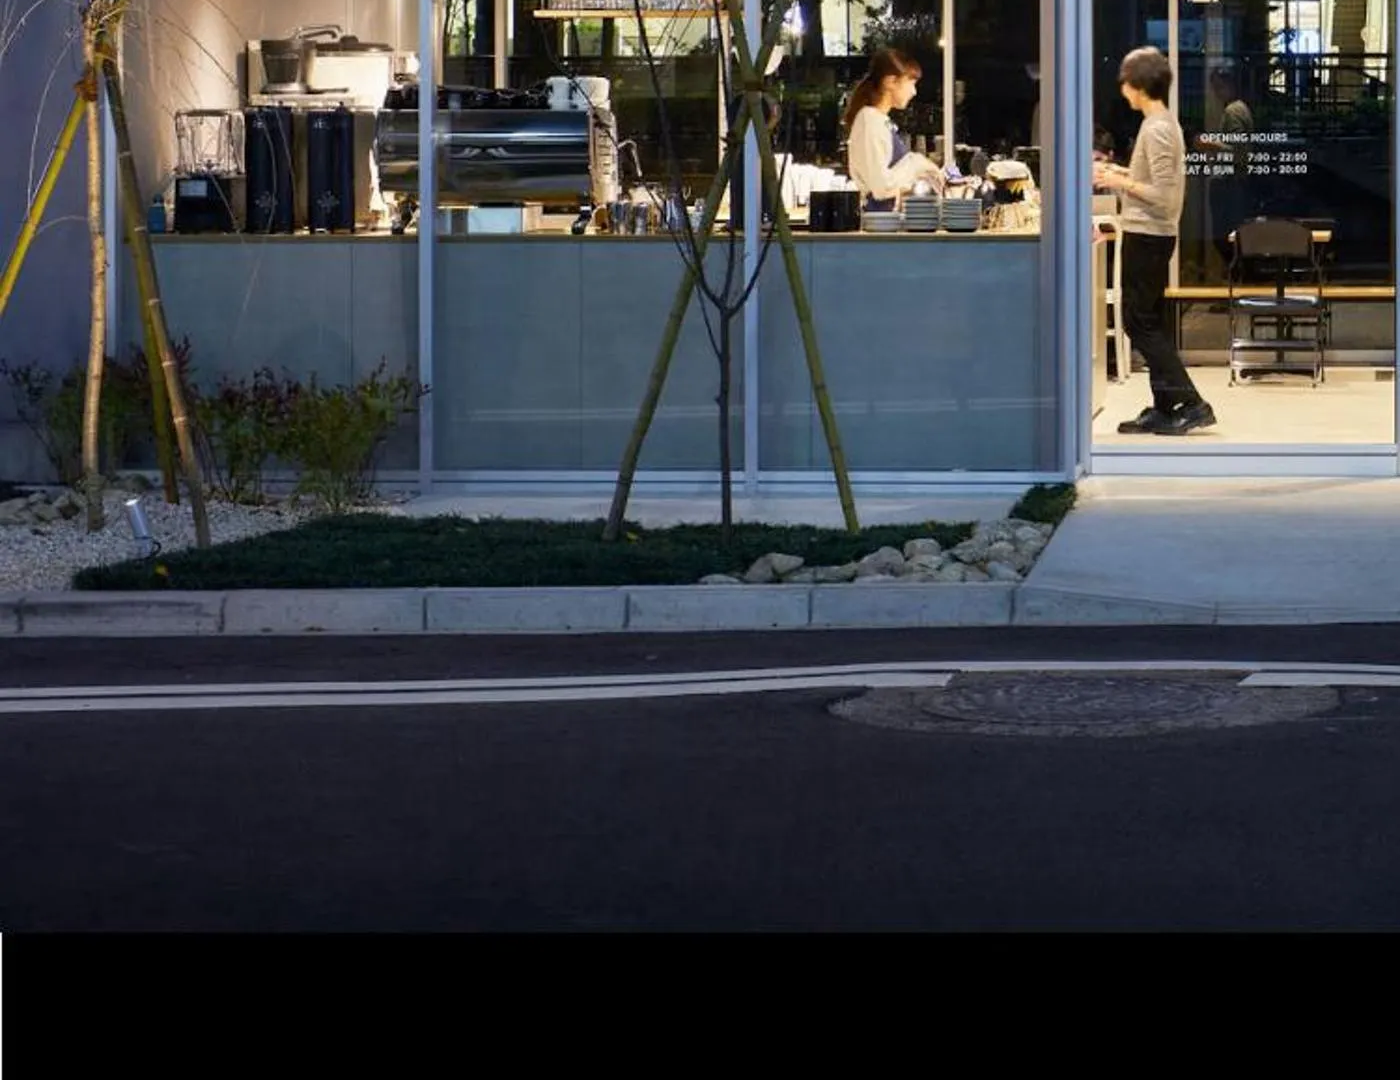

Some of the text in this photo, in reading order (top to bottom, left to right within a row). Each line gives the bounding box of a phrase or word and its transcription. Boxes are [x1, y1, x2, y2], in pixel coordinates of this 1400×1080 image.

[1200, 132, 1288, 143] OPENING HOURS
[1217, 152, 1234, 162] FRI
[1184, 165, 1201, 175] AT
[1213, 165, 1234, 175] SUN
